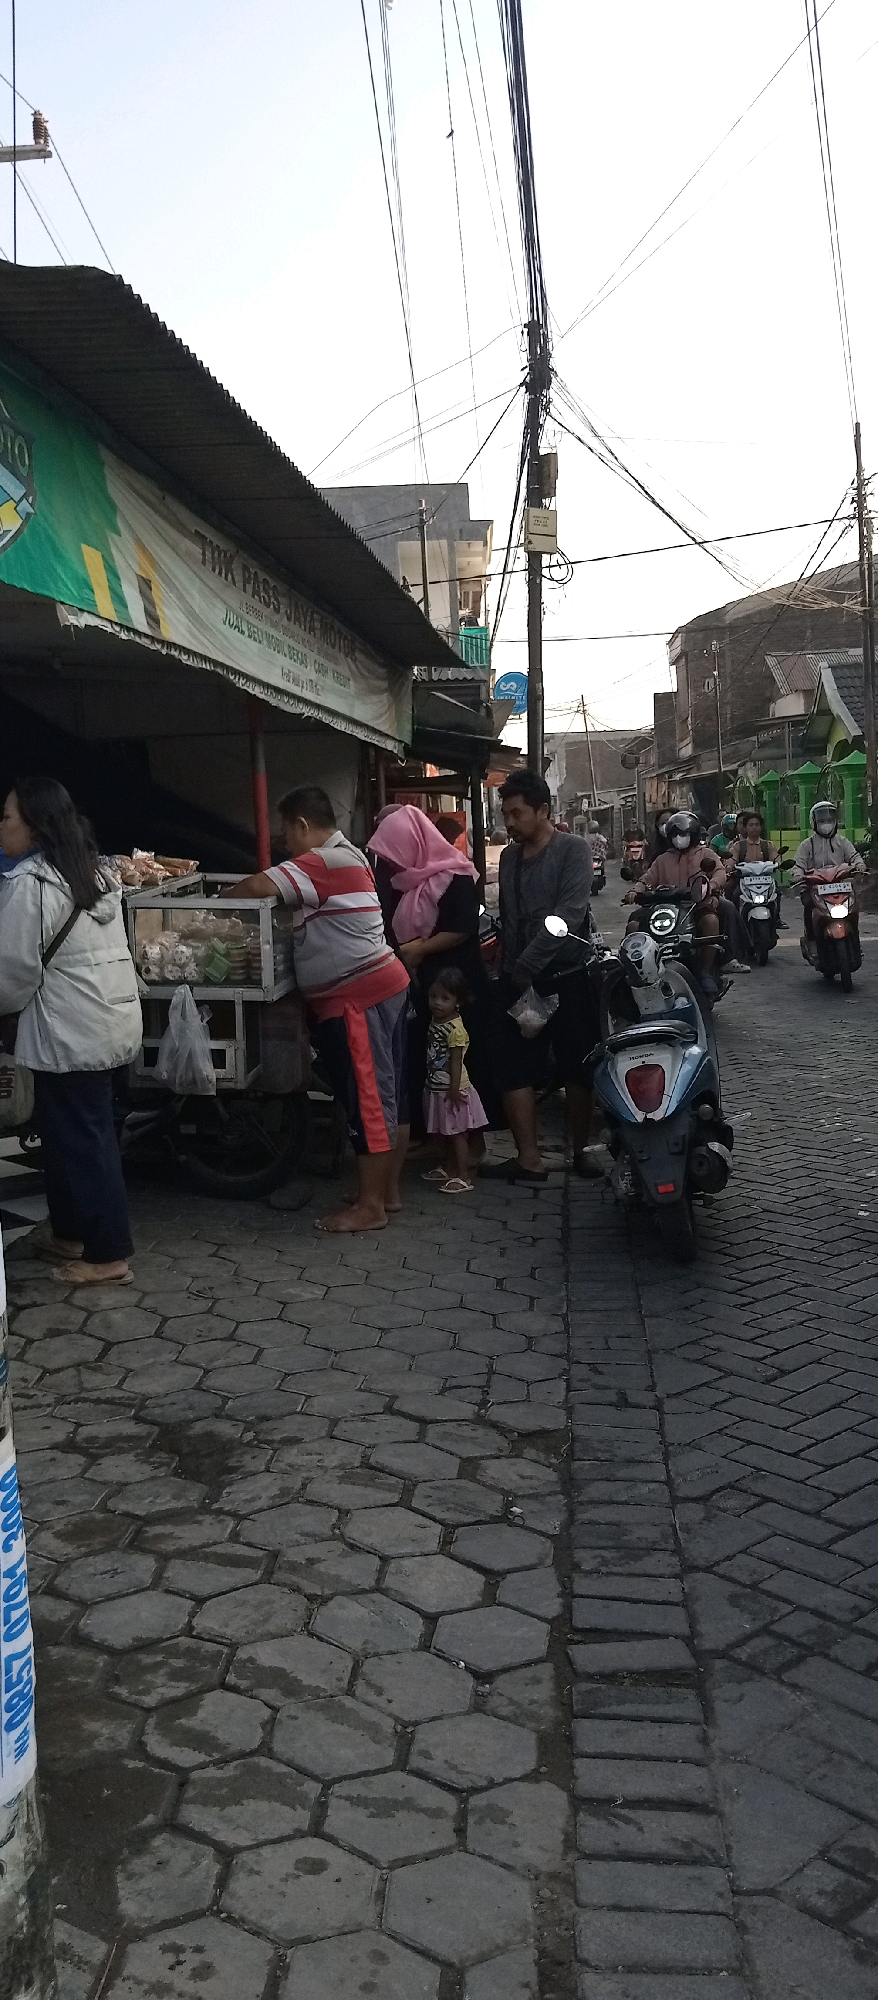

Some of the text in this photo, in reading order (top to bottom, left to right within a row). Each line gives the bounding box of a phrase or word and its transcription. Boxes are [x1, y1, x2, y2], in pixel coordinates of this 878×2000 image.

[0, 424, 29, 478] TO
[222, 607, 245, 635] JUAL
[242, 562, 281, 614] PASS
[285, 588, 316, 638] JAYA
[320, 616, 356, 662] MOTOR
[629, 1053, 654, 1061] HONDA
[3, 1553, 30, 1643] 0791
[4, 1642, 34, 1733] 0857
